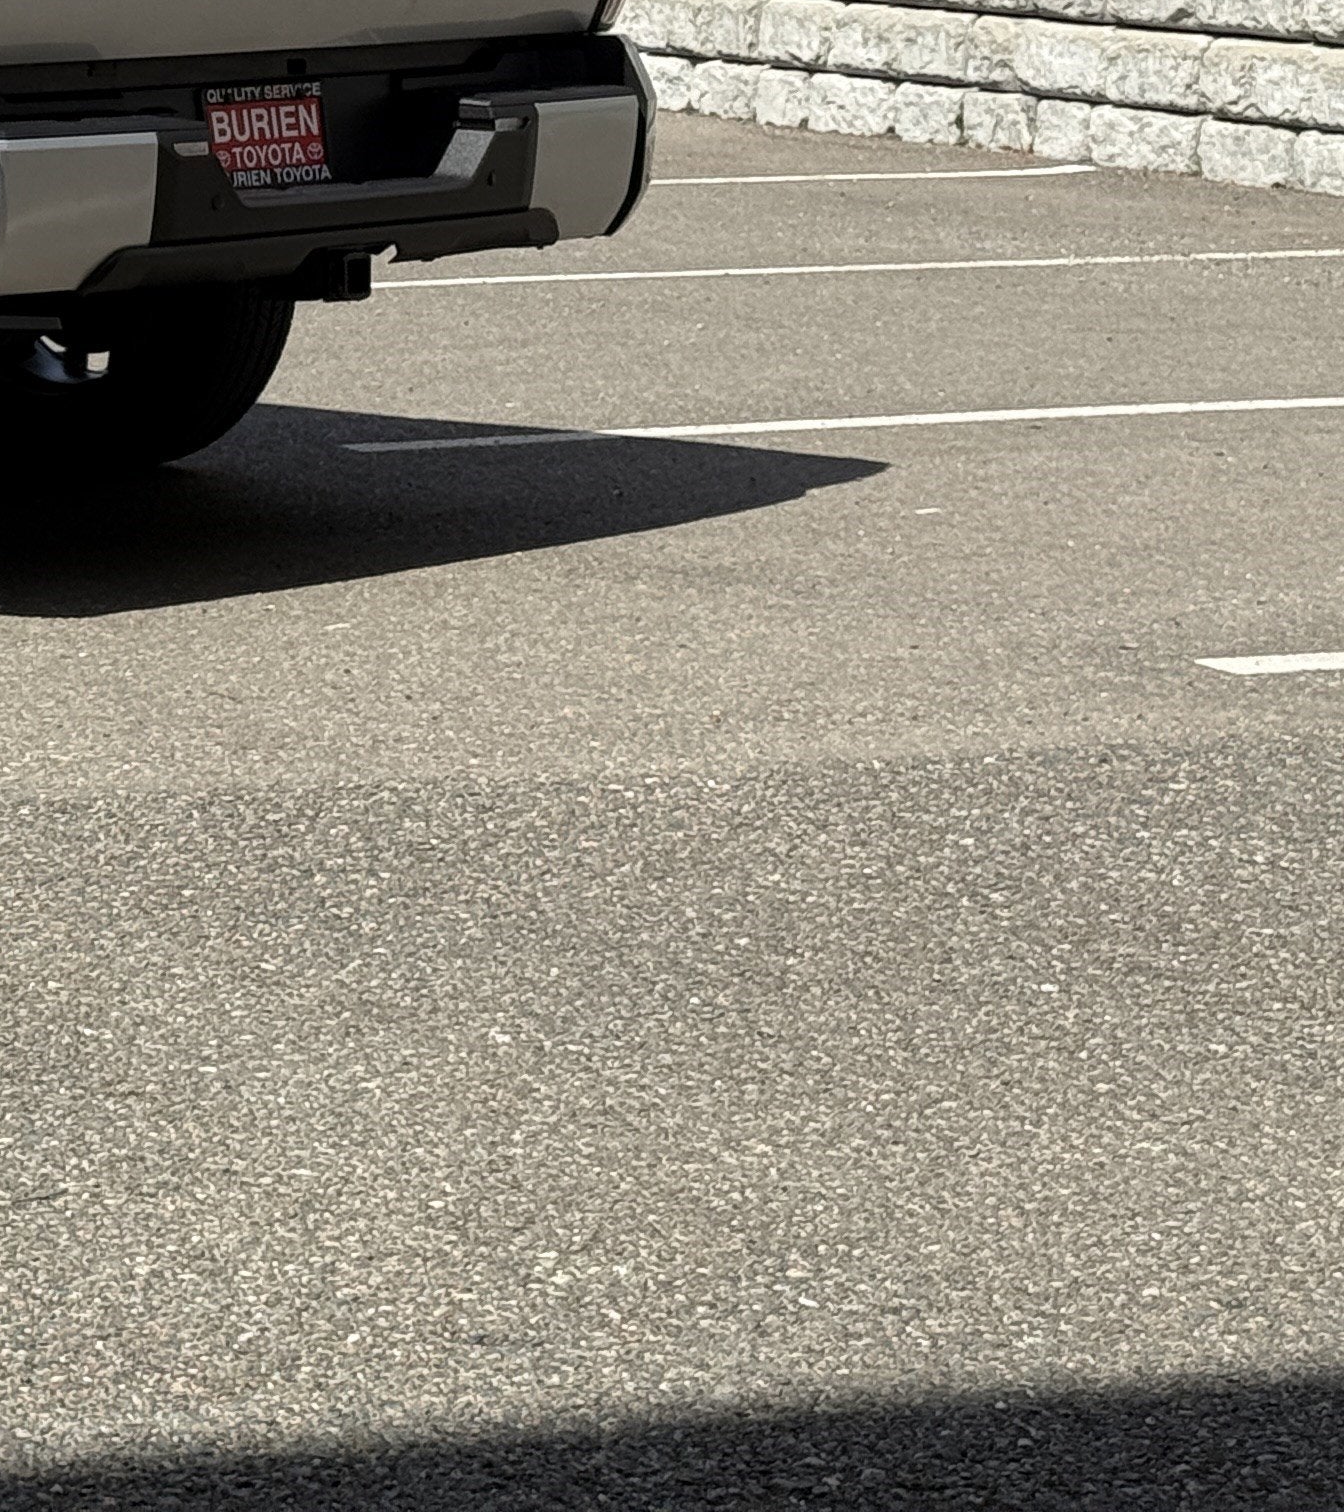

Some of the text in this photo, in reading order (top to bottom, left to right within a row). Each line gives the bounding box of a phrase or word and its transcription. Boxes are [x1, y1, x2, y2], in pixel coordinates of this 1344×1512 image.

[211, 104, 319, 143] BURIEN
[231, 142, 306, 169] TOYOTA
[228, 164, 332, 187] URIEN TOYOTA
